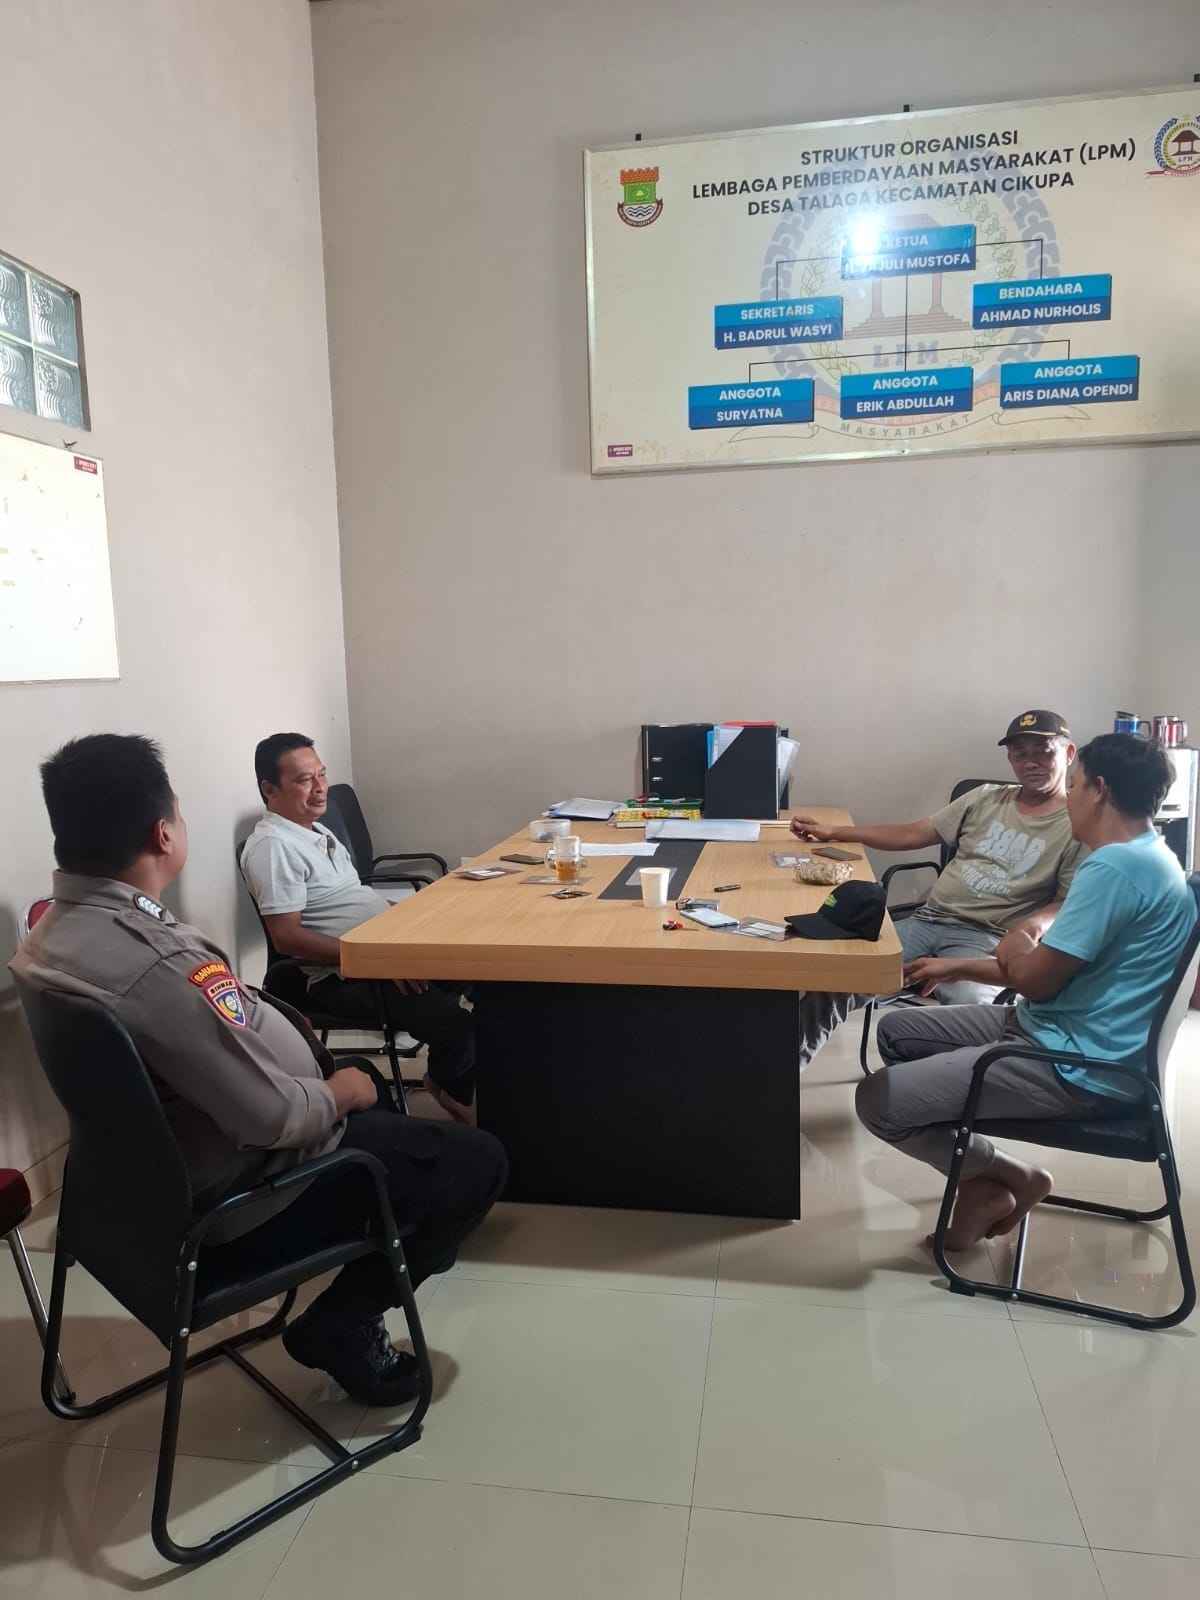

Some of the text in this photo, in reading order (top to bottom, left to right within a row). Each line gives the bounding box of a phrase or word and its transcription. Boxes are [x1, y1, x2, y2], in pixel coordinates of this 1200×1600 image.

[801, 130, 1018, 166] STRUKTUR ORGANISASI
[693, 137, 1136, 199] LEMBAGA PEMBERDAYAAN MASYARAKAT (LPM)
[748, 171, 1075, 216] DESA TALAGA KECAMATAN CIKUPA
[906, 253, 971, 269] MUSTOFA
[999, 282, 1083, 300] BENDAHARA
[740, 303, 815, 320] SEKRETARIS
[980, 303, 1101, 323] AHMAD NURHOLIS
[723, 324, 832, 343] H. BADRUL WASYI
[1034, 364, 1103, 379] ANGGOTA
[873, 375, 938, 390] ANGGOTA
[719, 386, 782, 401] ANGGOTA
[1004, 383, 1133, 402] ARIS DIANA OPENDI
[856, 396, 954, 413] ERIK ABDULLAH
[716, 407, 783, 422] SURYATNA
[840, 414, 970, 436] MASYARAKAT
